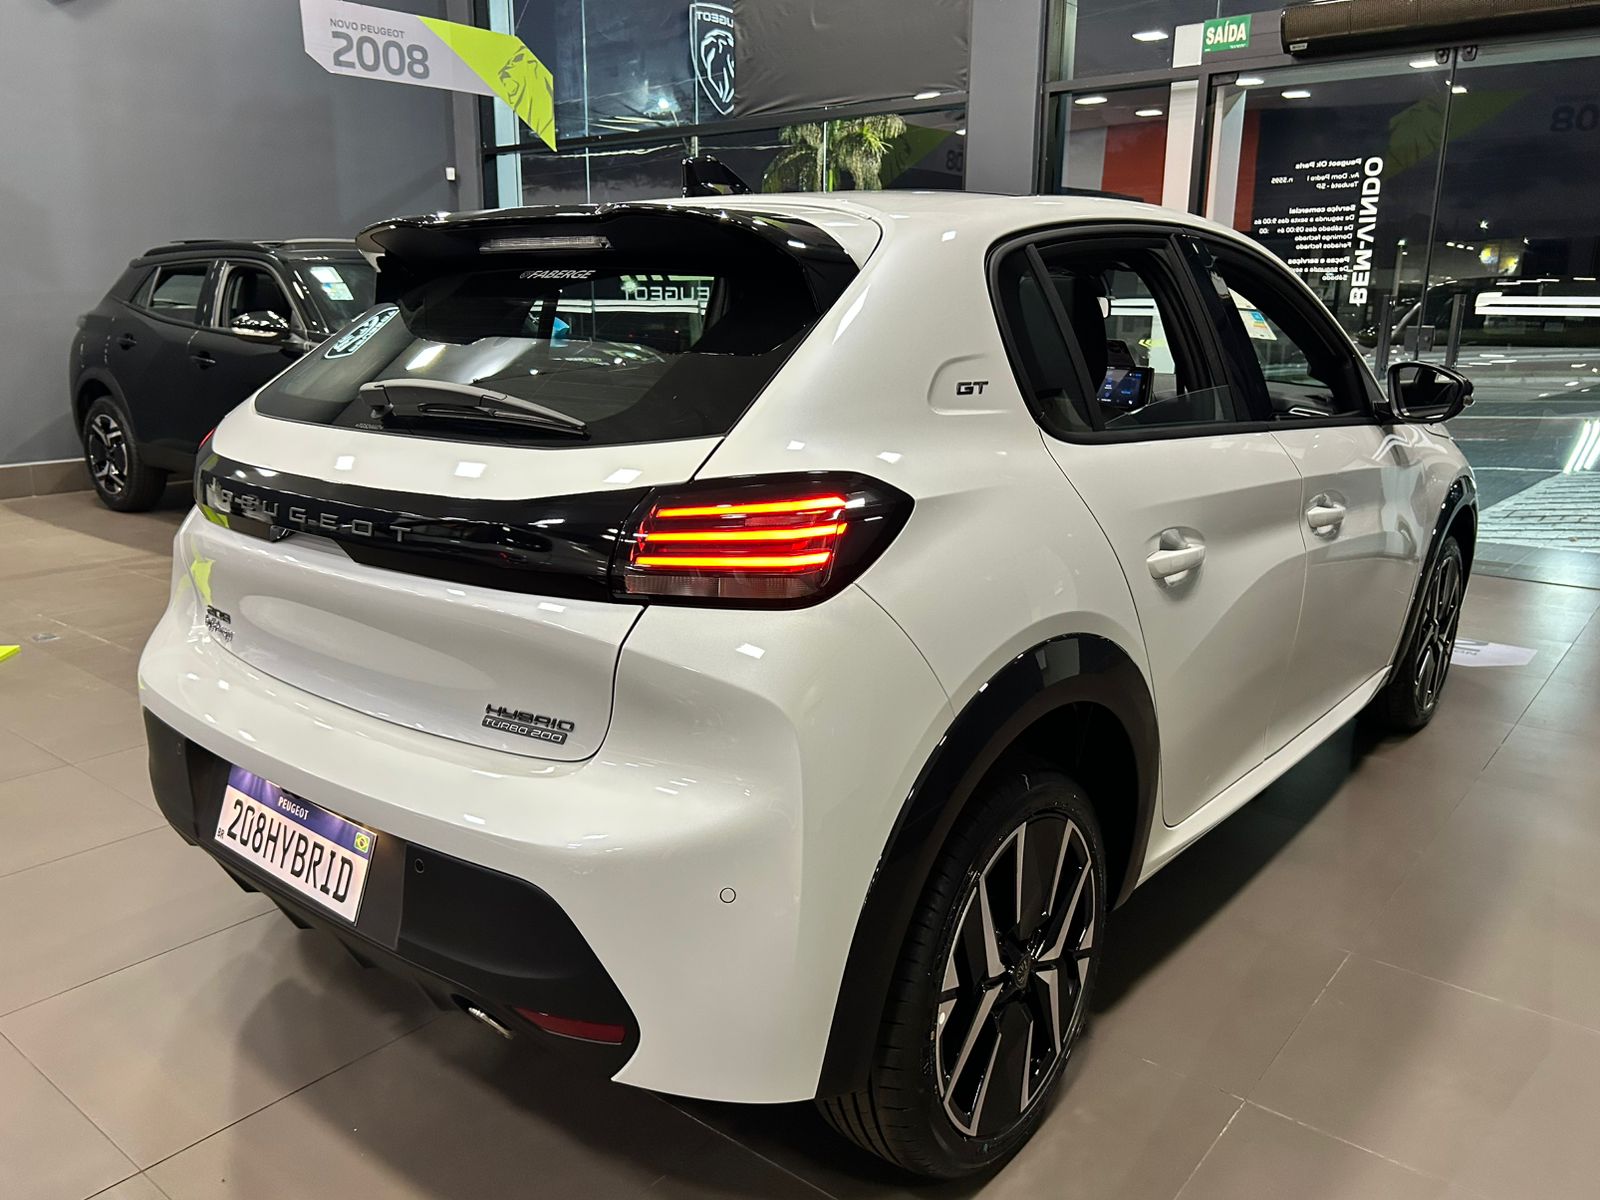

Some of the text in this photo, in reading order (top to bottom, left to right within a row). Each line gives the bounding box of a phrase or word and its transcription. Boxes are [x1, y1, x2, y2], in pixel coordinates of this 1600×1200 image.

[330, 18, 405, 39] NOVO PEUGEOT
[1205, 20, 1247, 45] SAÍDA
[331, 30, 430, 79] 2008
[956, 381, 989, 396] GT
[485, 703, 575, 733] HYBRID
[485, 718, 563, 742] TURBO 200
[277, 796, 309, 820] PEUGEOT
[217, 827, 225, 840] BR
[226, 798, 354, 903] 208HYBRID
